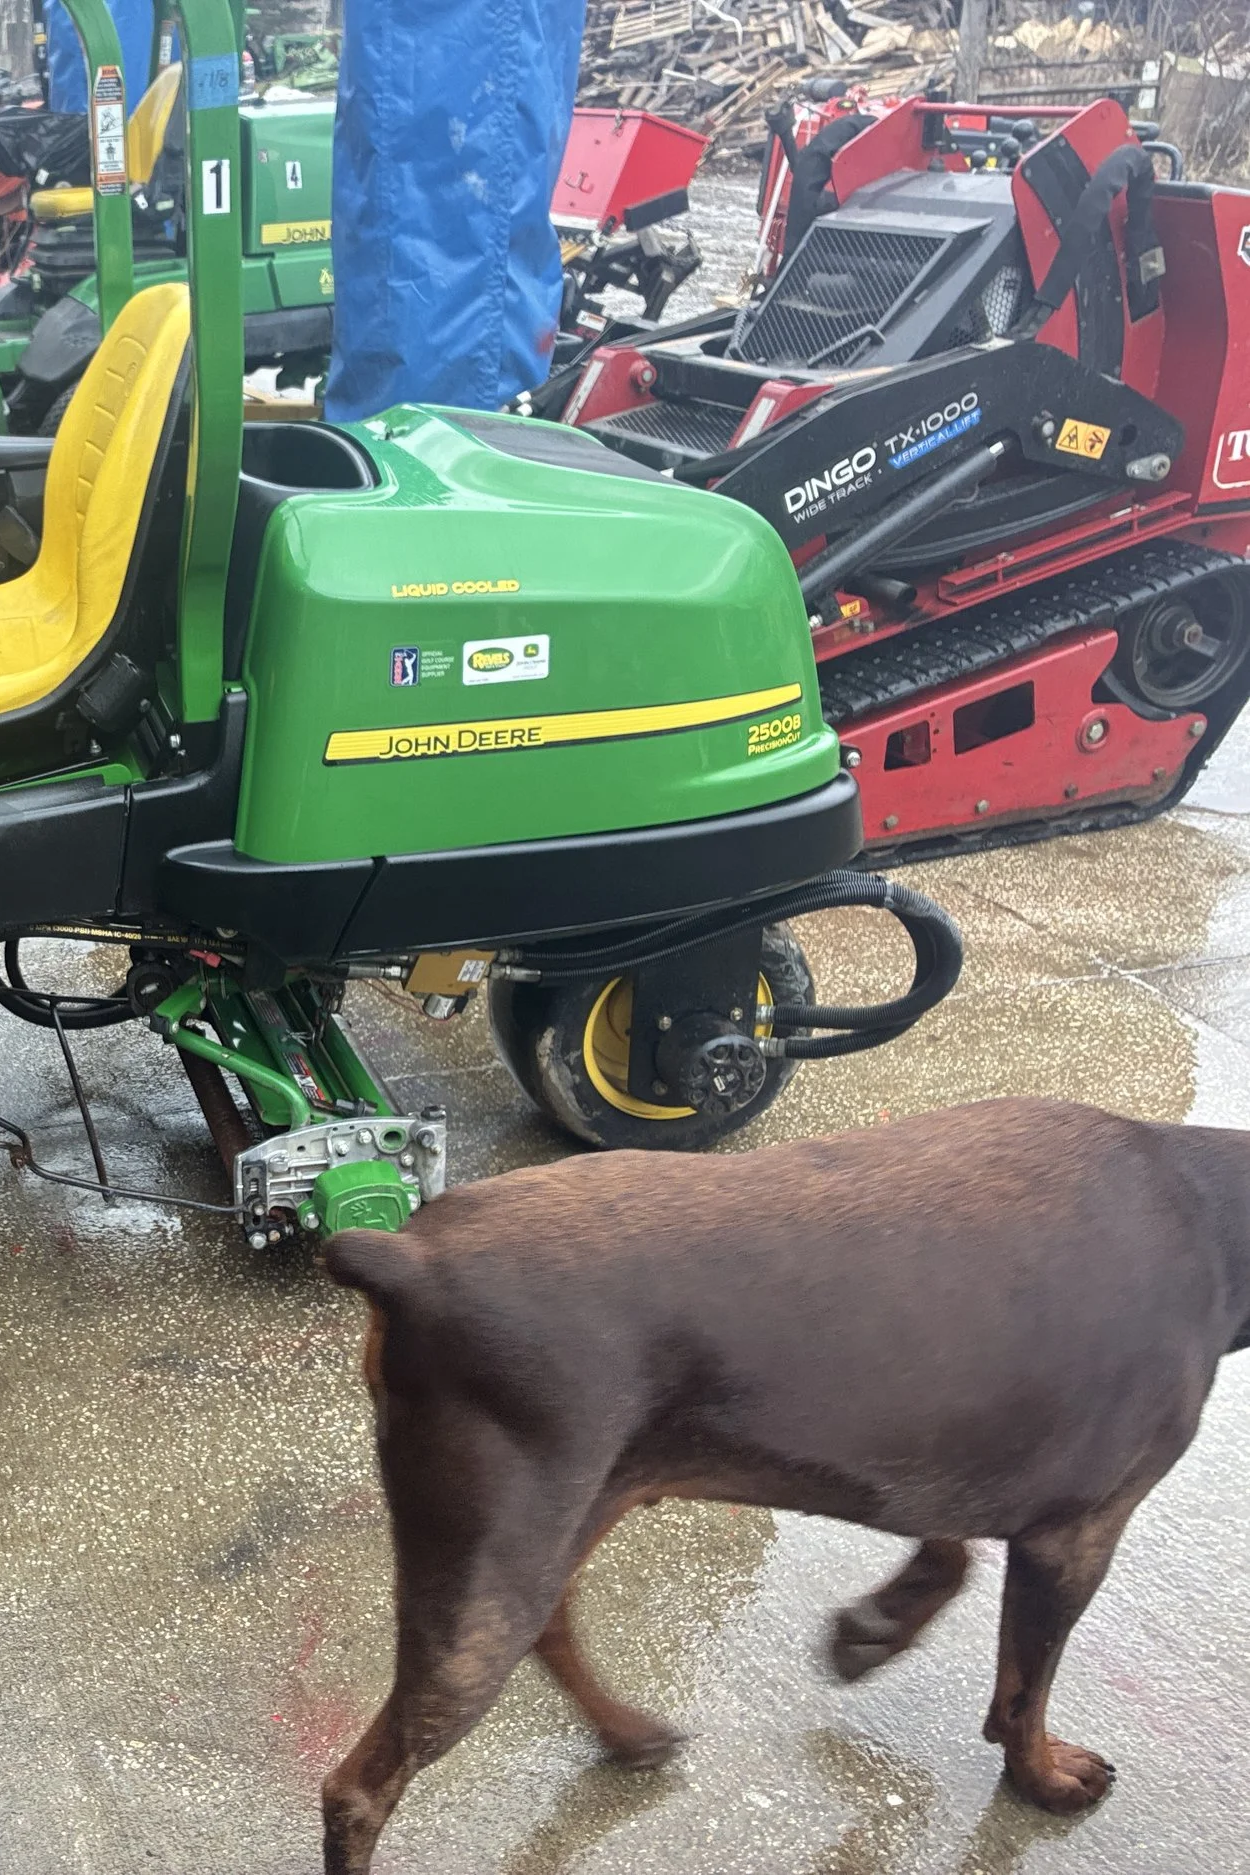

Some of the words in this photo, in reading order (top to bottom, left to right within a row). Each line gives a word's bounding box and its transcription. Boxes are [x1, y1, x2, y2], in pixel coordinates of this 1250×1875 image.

[210, 160, 224, 209] 1
[290, 163, 299, 187] 4
[281, 227, 326, 243] JOHN
[892, 428, 952, 466] VERTICAL
[953, 413, 981, 435] LIFT
[784, 446, 877, 514] DINGO
[793, 498, 827, 525] WIDE
[828, 474, 873, 506] TRACK
[391, 583, 449, 598] LIQUID
[452, 579, 520, 594] COOLED
[473, 652, 510, 669] REVELS
[379, 735, 450, 756] JOHN
[458, 727, 542, 749] DEERE
[748, 713, 801, 744] 2500B
[91, 928, 113, 938] MSHA
